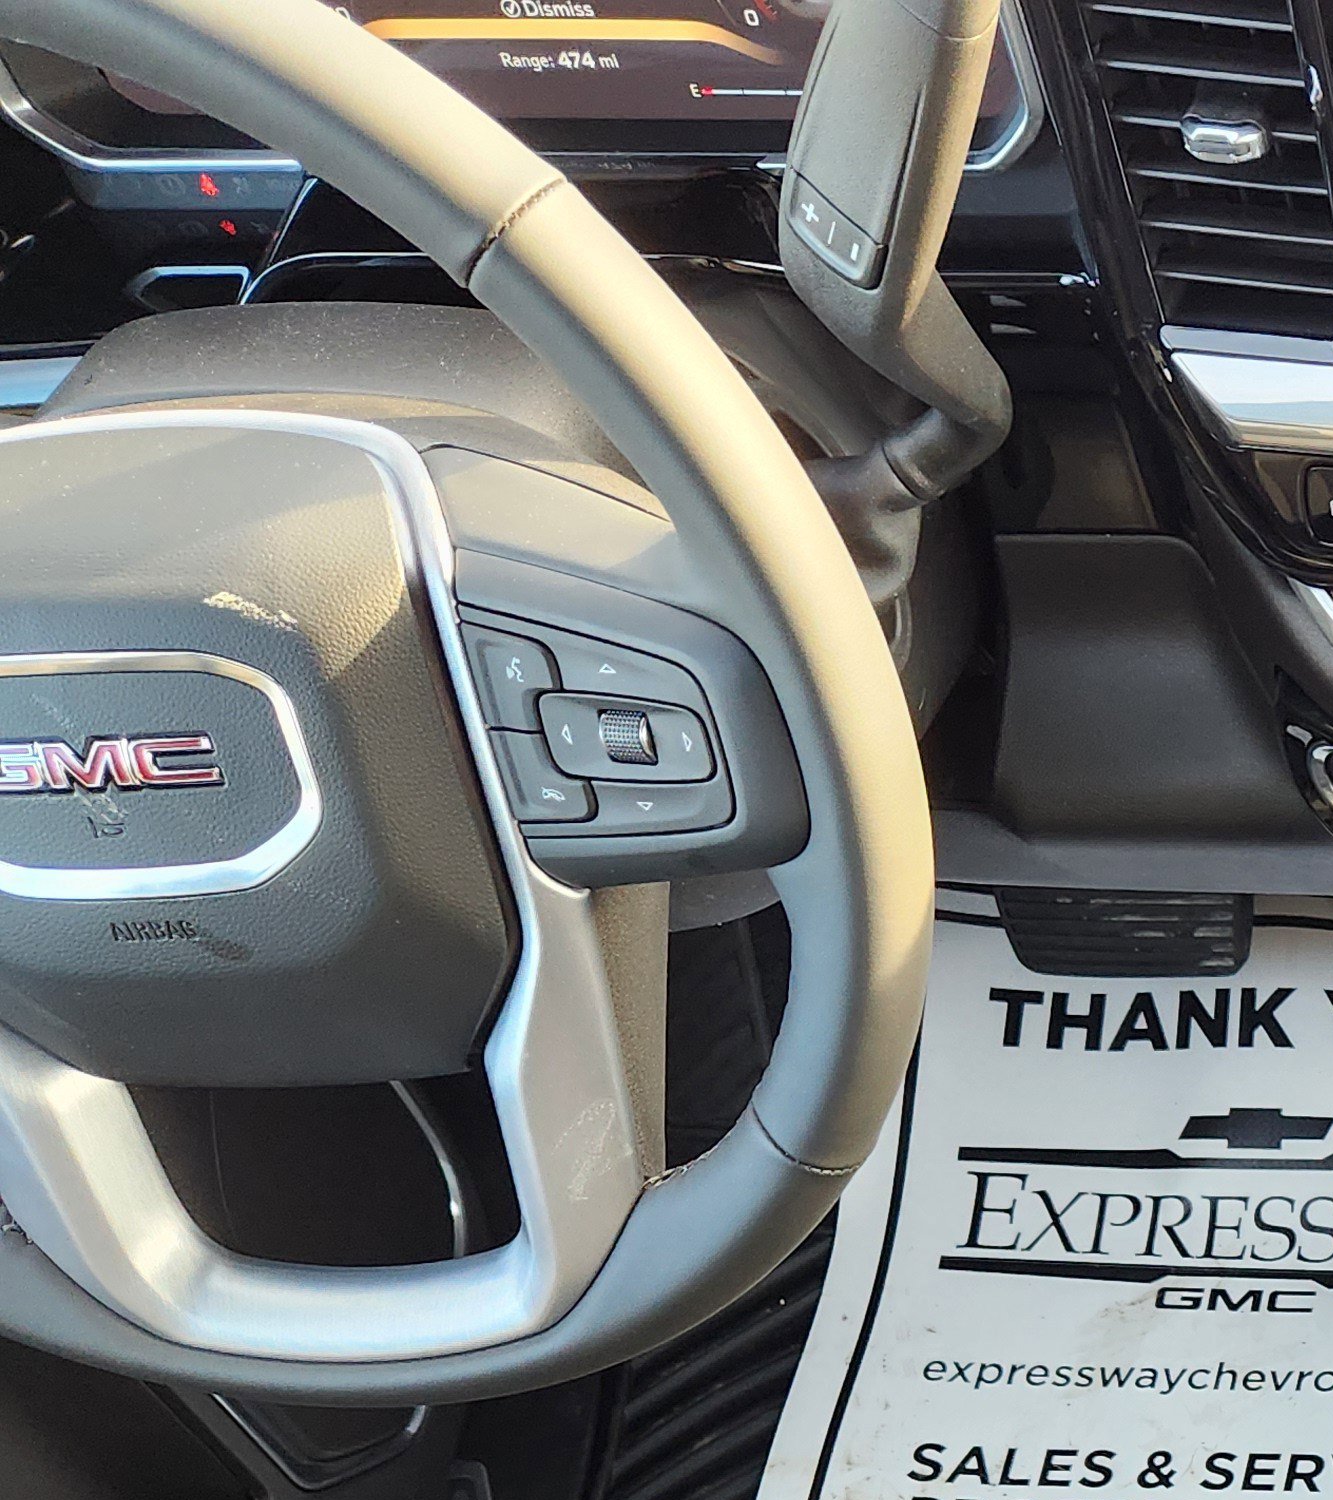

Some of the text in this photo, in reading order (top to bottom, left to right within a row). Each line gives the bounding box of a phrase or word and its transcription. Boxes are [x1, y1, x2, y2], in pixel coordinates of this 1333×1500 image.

[523, 0, 596, 18] Dismiss
[499, 51, 620, 72] Range: 474 mi
[689, 83, 702, 98] E
[109, 920, 198, 942] AIRBAG
[988, 986, 1295, 1053] THANK
[1154, 1287, 1318, 1314] GMC
[906, 1442, 1114, 1489] SALES
[1135, 1450, 1174, 1489] &
